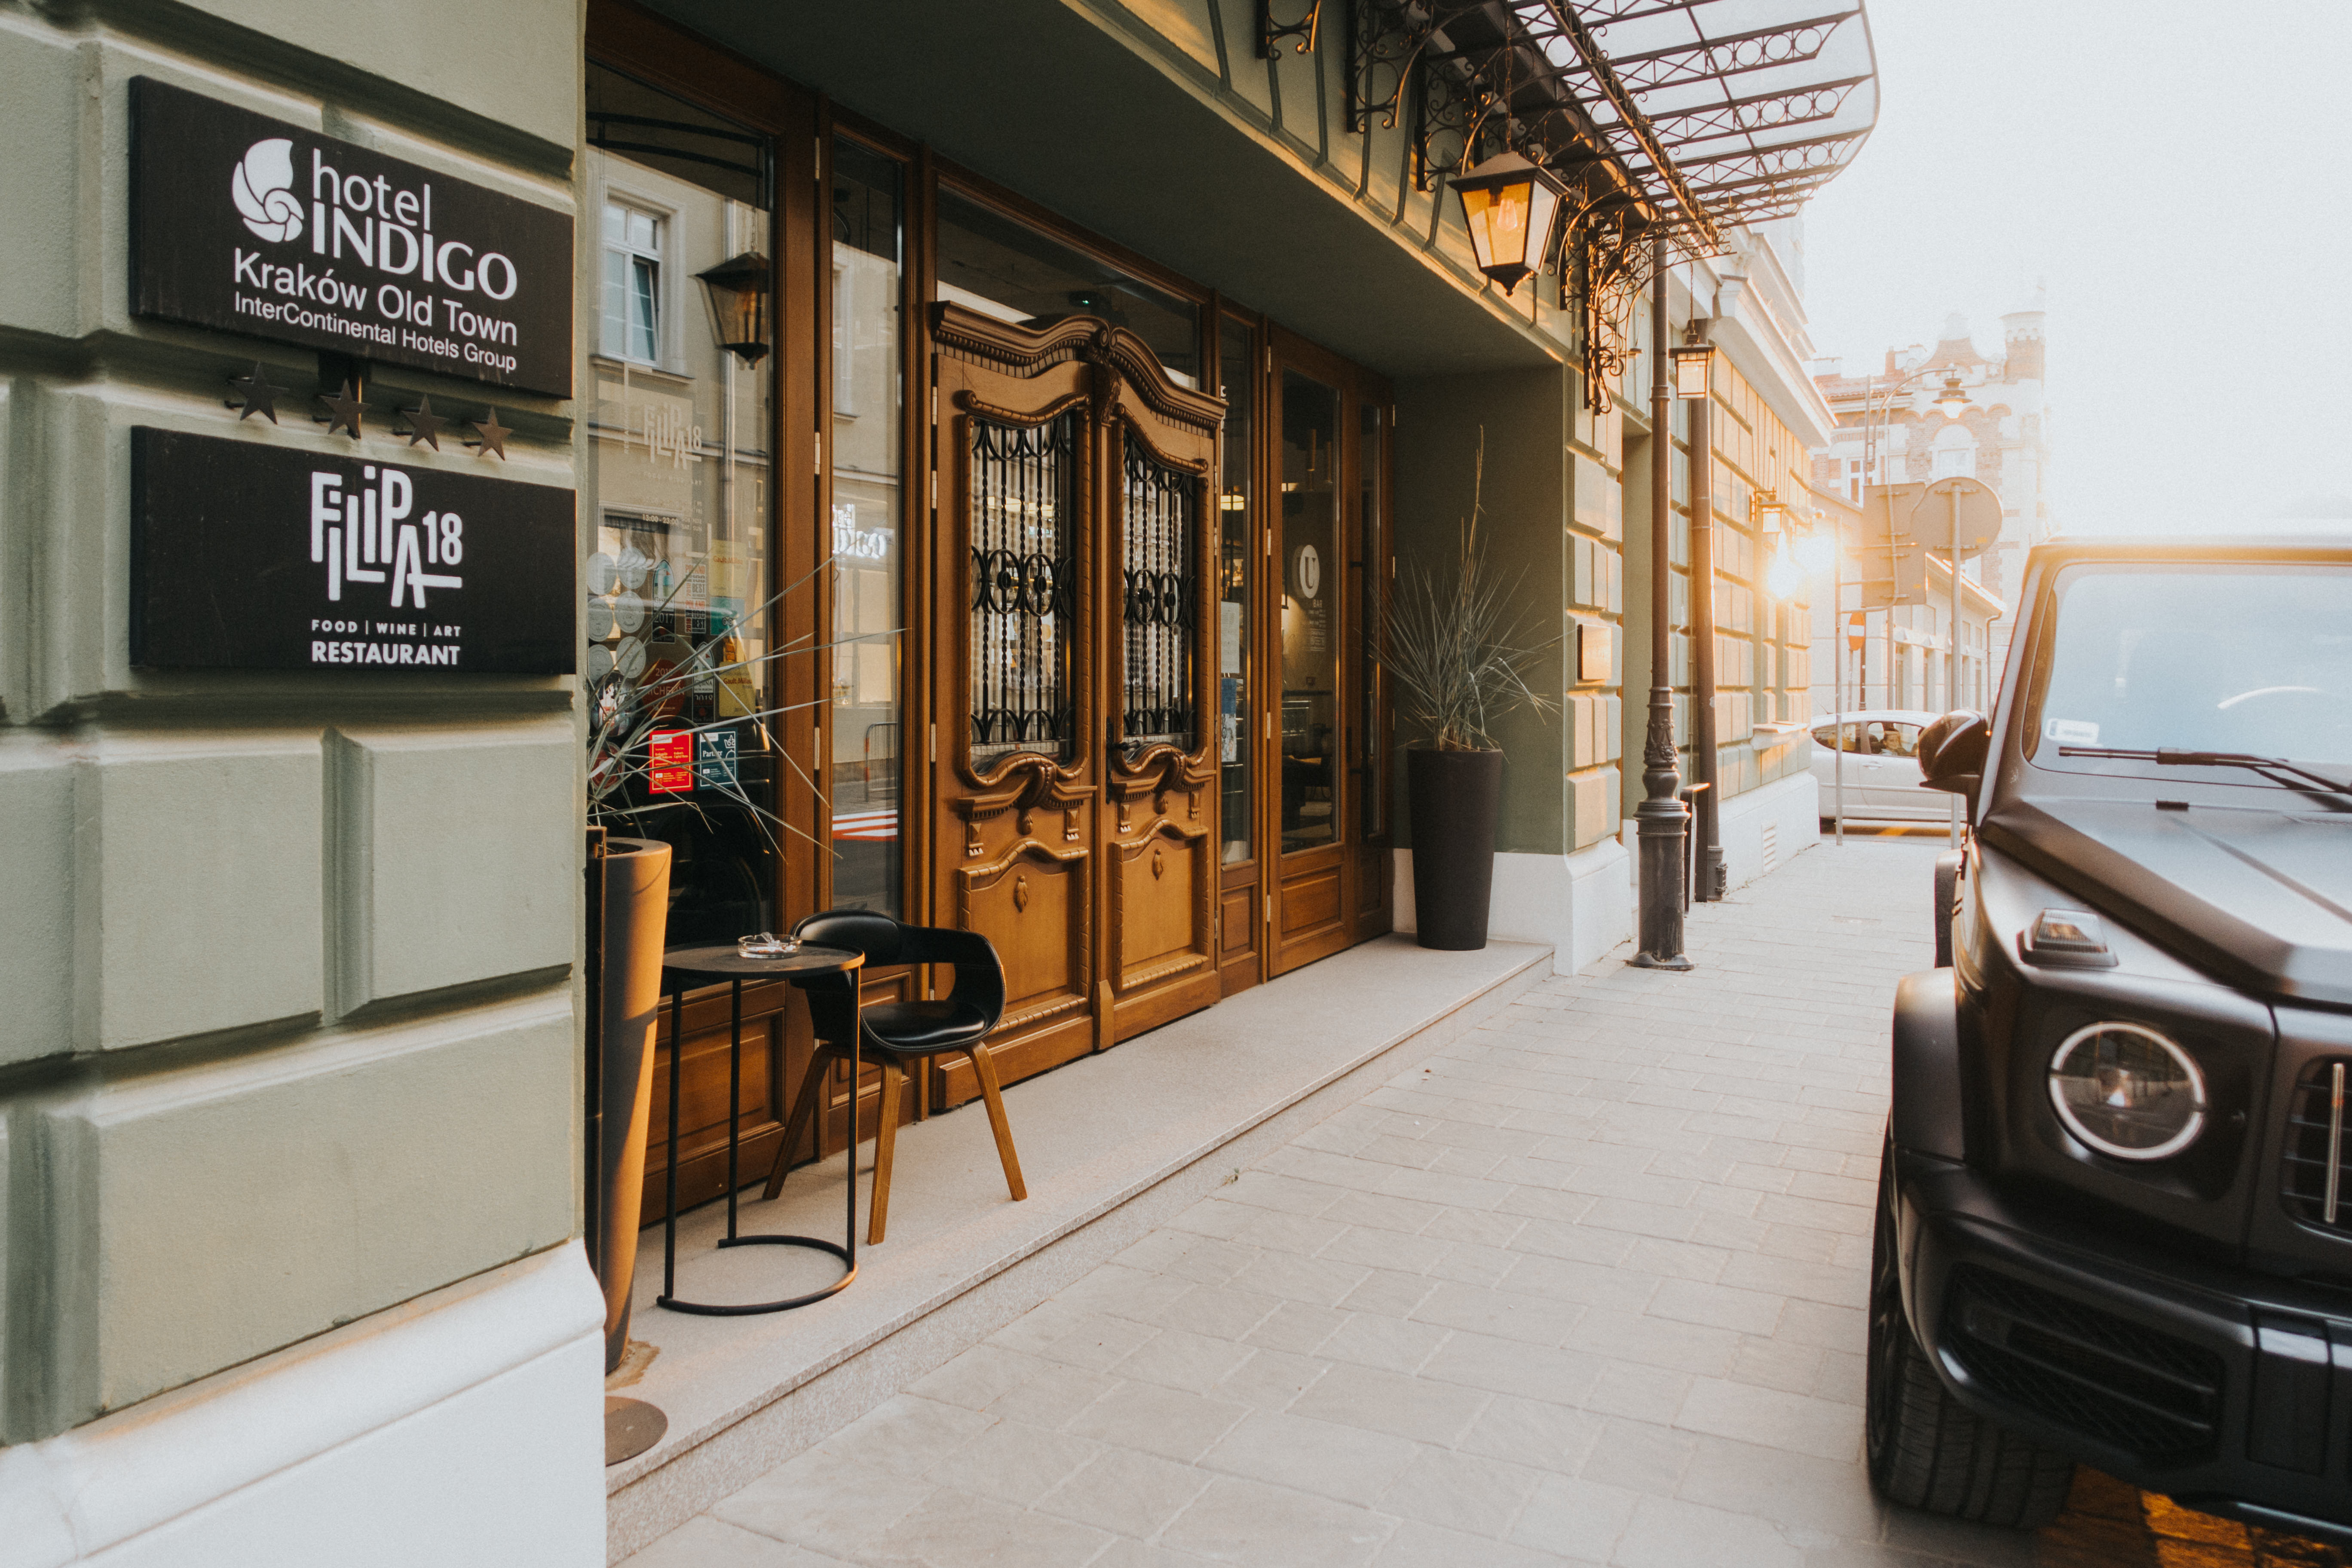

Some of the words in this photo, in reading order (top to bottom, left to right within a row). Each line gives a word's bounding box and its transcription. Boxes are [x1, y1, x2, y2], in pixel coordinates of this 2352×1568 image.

[313, 149, 430, 230] hotel
[313, 201, 517, 300] INDIGO
[235, 248, 367, 310] Kraków
[378, 285, 432, 326] Old
[443, 298, 517, 346] Town
[236, 292, 396, 344] InterContinental
[403, 329, 459, 358] Hotels
[464, 343, 517, 373] Group
[423, 511, 462, 565] 18
[642, 514, 658, 522] 13:00
[692, 583, 705, 593] BEST
[654, 613, 674, 623] 2017
[692, 619, 705, 628] BEST
